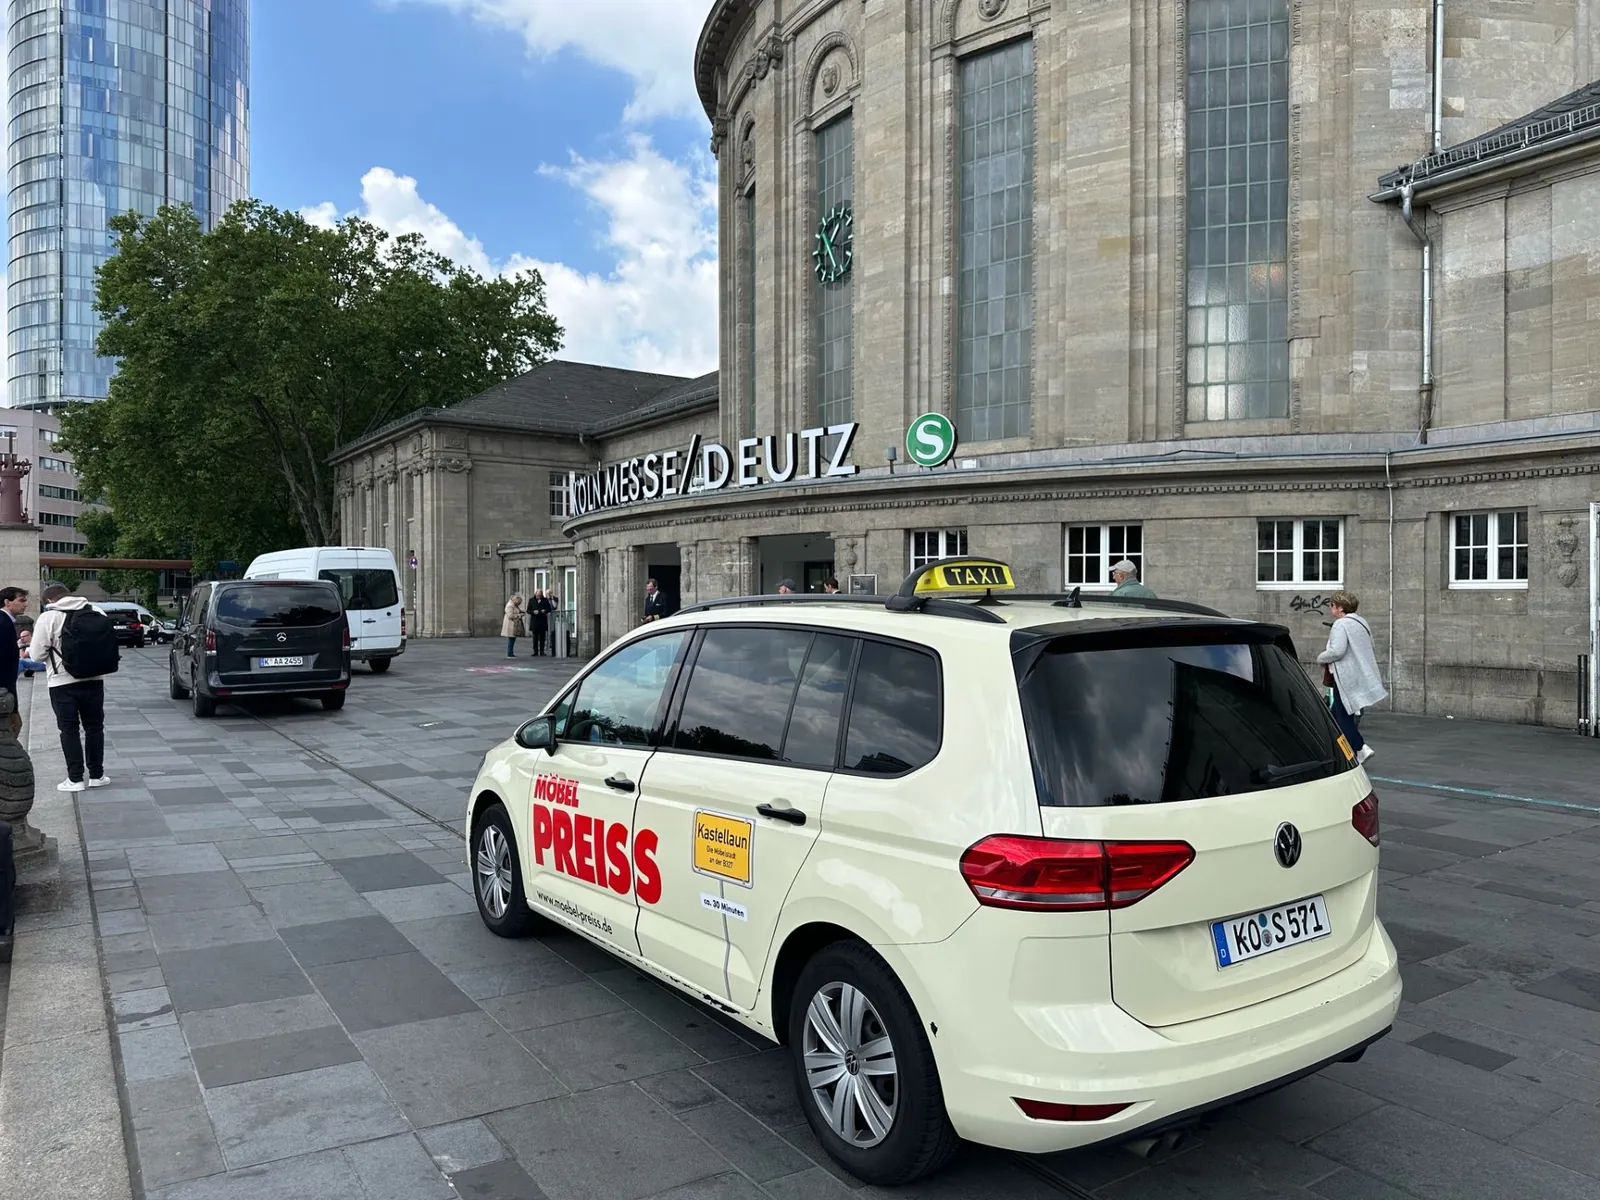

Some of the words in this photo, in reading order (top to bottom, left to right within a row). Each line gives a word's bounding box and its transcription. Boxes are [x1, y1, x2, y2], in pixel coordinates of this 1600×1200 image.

[915, 420, 944, 460] S
[571, 470, 603, 516] KÖLN
[950, 568, 999, 585] TAXI
[533, 773, 580, 808] MÖBEL
[697, 822, 748, 850] Kastellaun
[706, 845, 714, 854] Die
[533, 803, 662, 905] PREISS
[536, 890, 613, 935] www.moebel-preiss.de
[703, 898, 712, 906] ca.
[712, 900, 720, 909] 30
[720, 902, 745, 917] Minuten
[1220, 948, 1227, 959] D
[1233, 919, 1262, 955] KO
